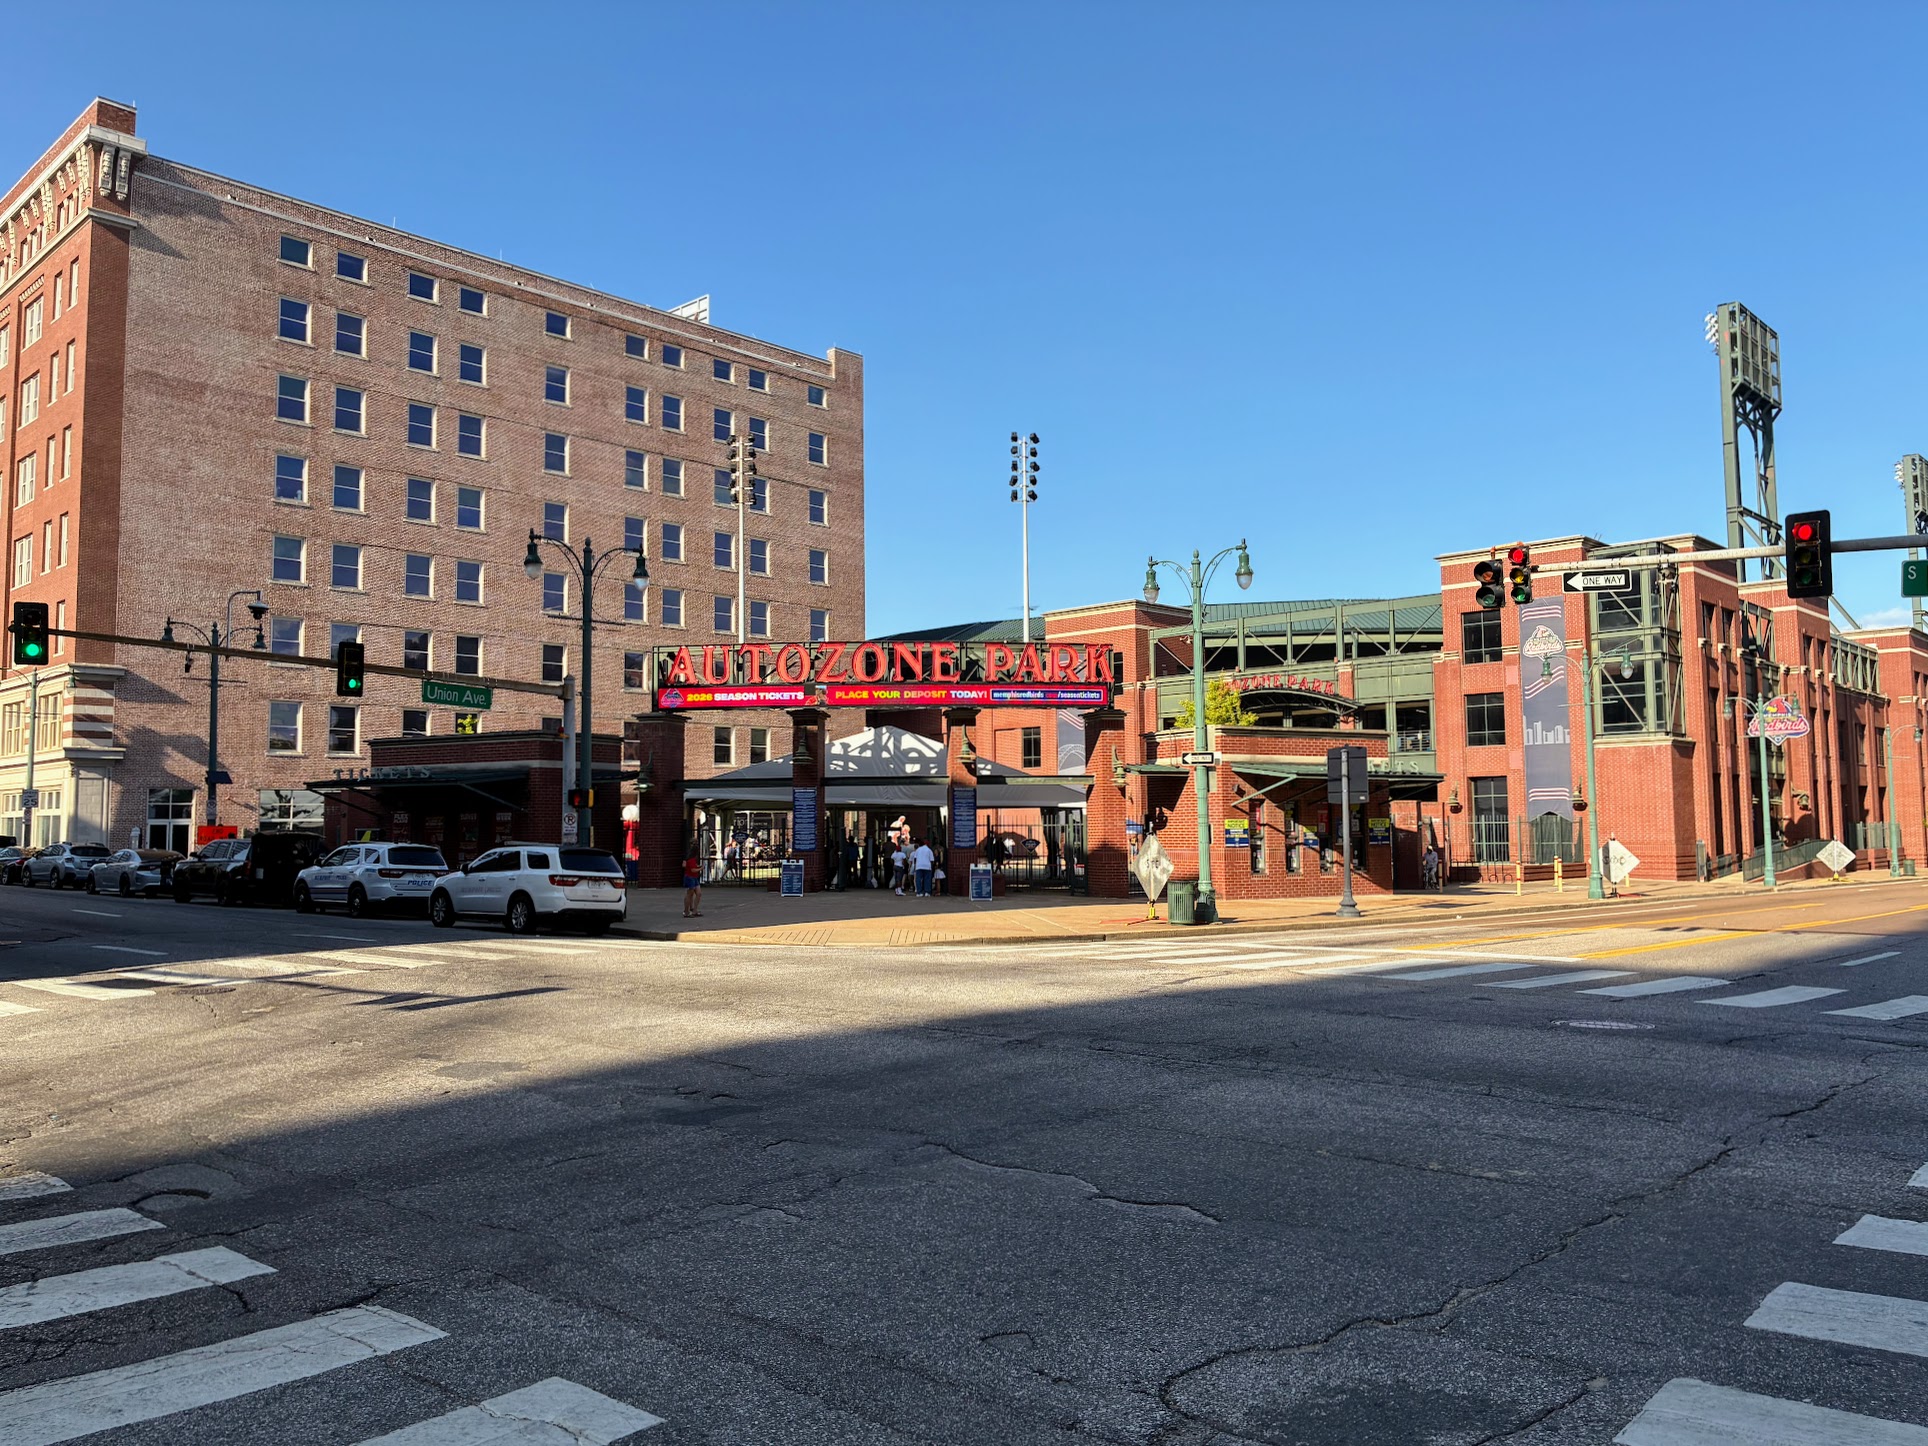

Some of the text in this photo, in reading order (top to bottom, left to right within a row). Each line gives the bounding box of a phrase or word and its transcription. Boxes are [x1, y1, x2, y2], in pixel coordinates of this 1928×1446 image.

[1908, 565, 1917, 580] S
[1582, 575, 1623, 586] ONE WAY
[666, 642, 1115, 685] AUTOZONE PARK
[1288, 675, 1335, 695] PARK
[426, 684, 487, 705] Union Ave.
[714, 692, 757, 702] SEASON
[758, 691, 805, 701] TICKETS
[835, 690, 869, 699] PLACE
[872, 690, 901, 699] YOUR
[904, 690, 947, 698] DEPOSIT
[950, 690, 988, 699] TODAY!
[993, 690, 1101, 699] memphisredbirds/seasontickets
[333, 766, 431, 781] TICKETS
[23, 798, 37, 806] 25
[406, 879, 433, 887] POLICE
